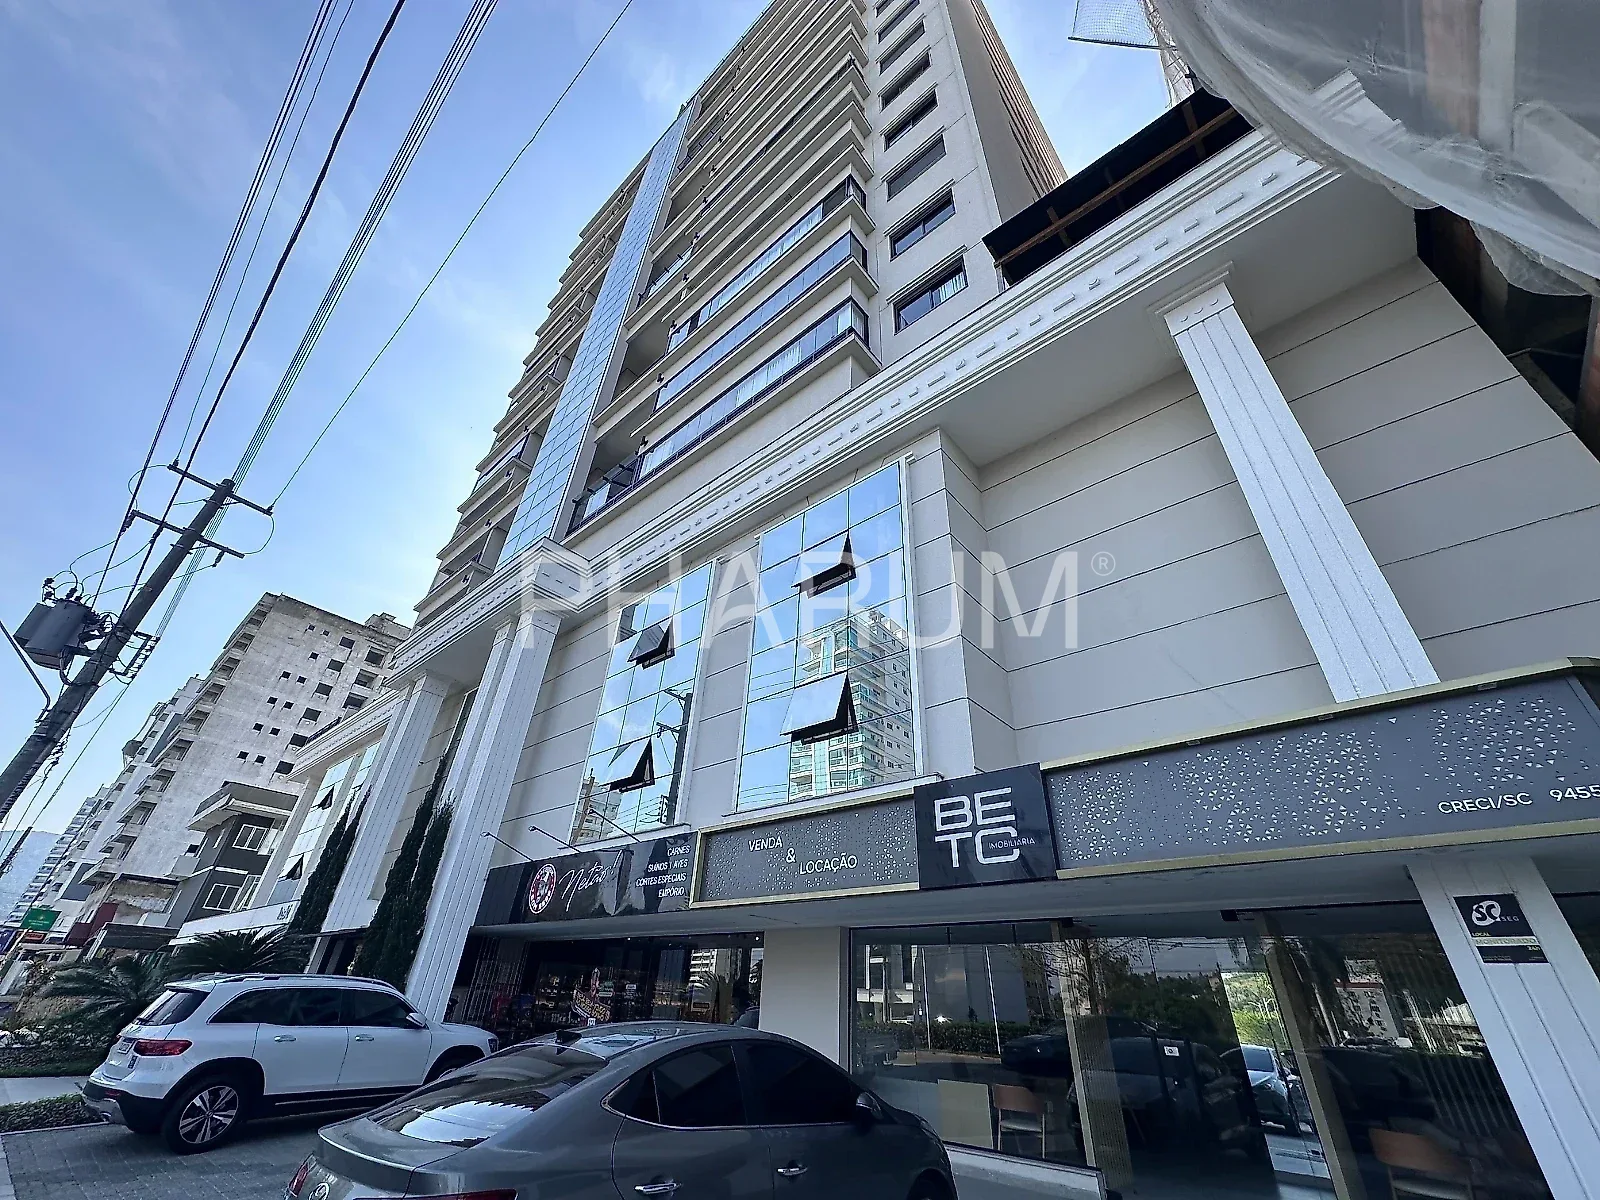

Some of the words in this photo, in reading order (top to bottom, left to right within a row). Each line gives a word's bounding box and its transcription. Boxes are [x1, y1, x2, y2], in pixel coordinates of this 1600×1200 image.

[1438, 792, 1533, 814] CRECI/SC
[666, 845, 692, 857] CARNES
[748, 836, 784, 852] VENDA
[785, 847, 797, 864] &
[799, 852, 859, 875] LOCAÇÃO
[635, 876, 658, 887] CORTES
[657, 872, 687, 885] ESPECIAIS
